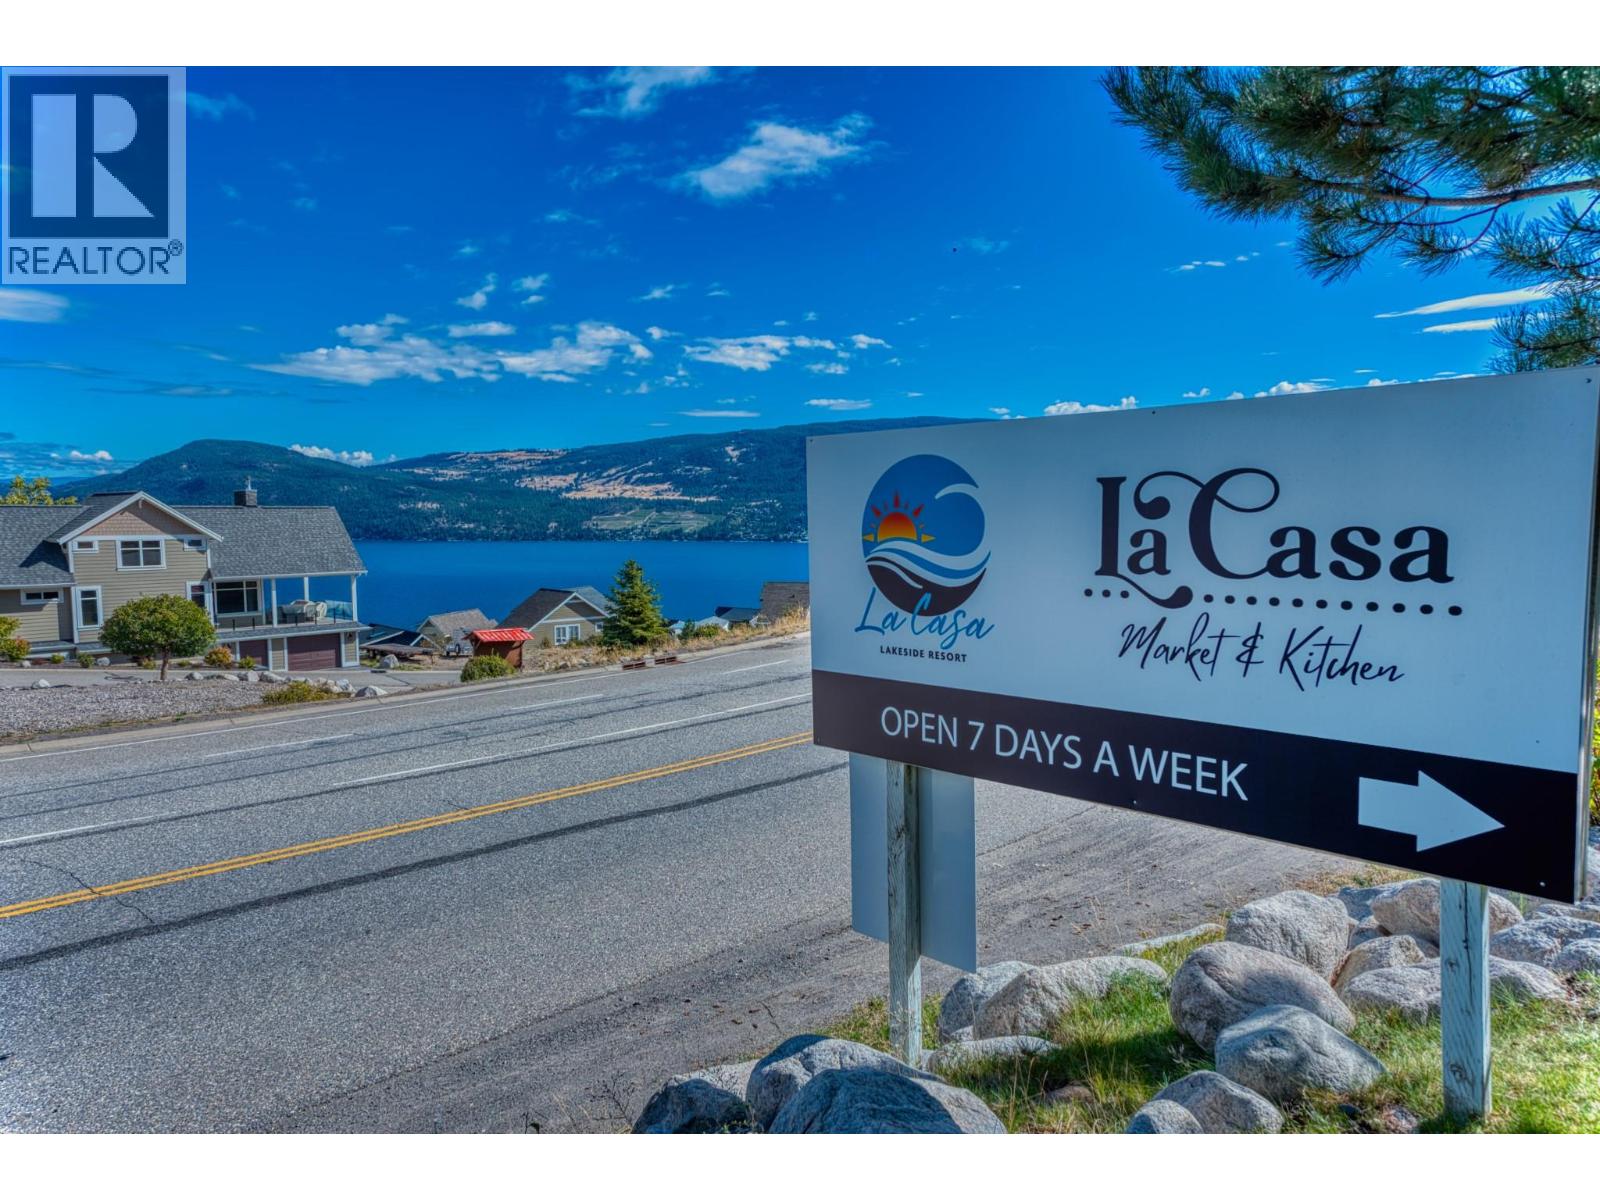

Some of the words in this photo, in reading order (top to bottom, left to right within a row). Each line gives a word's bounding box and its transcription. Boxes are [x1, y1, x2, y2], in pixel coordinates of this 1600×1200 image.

[1094, 476, 1193, 609] La
[1133, 468, 1455, 583] Casa
[854, 587, 907, 636] La
[911, 592, 995, 650] Casa
[880, 645, 925, 659] LAKESIDE
[928, 651, 967, 663] RESORT
[1118, 612, 1241, 682] Market
[1235, 621, 1264, 677] &
[1280, 624, 1405, 692] Kitchen
[881, 706, 958, 748] OPEN
[968, 721, 985, 751] 7
[995, 724, 1082, 770] DAYS
[1093, 741, 1119, 777] A
[1128, 745, 1249, 801] WEEK
